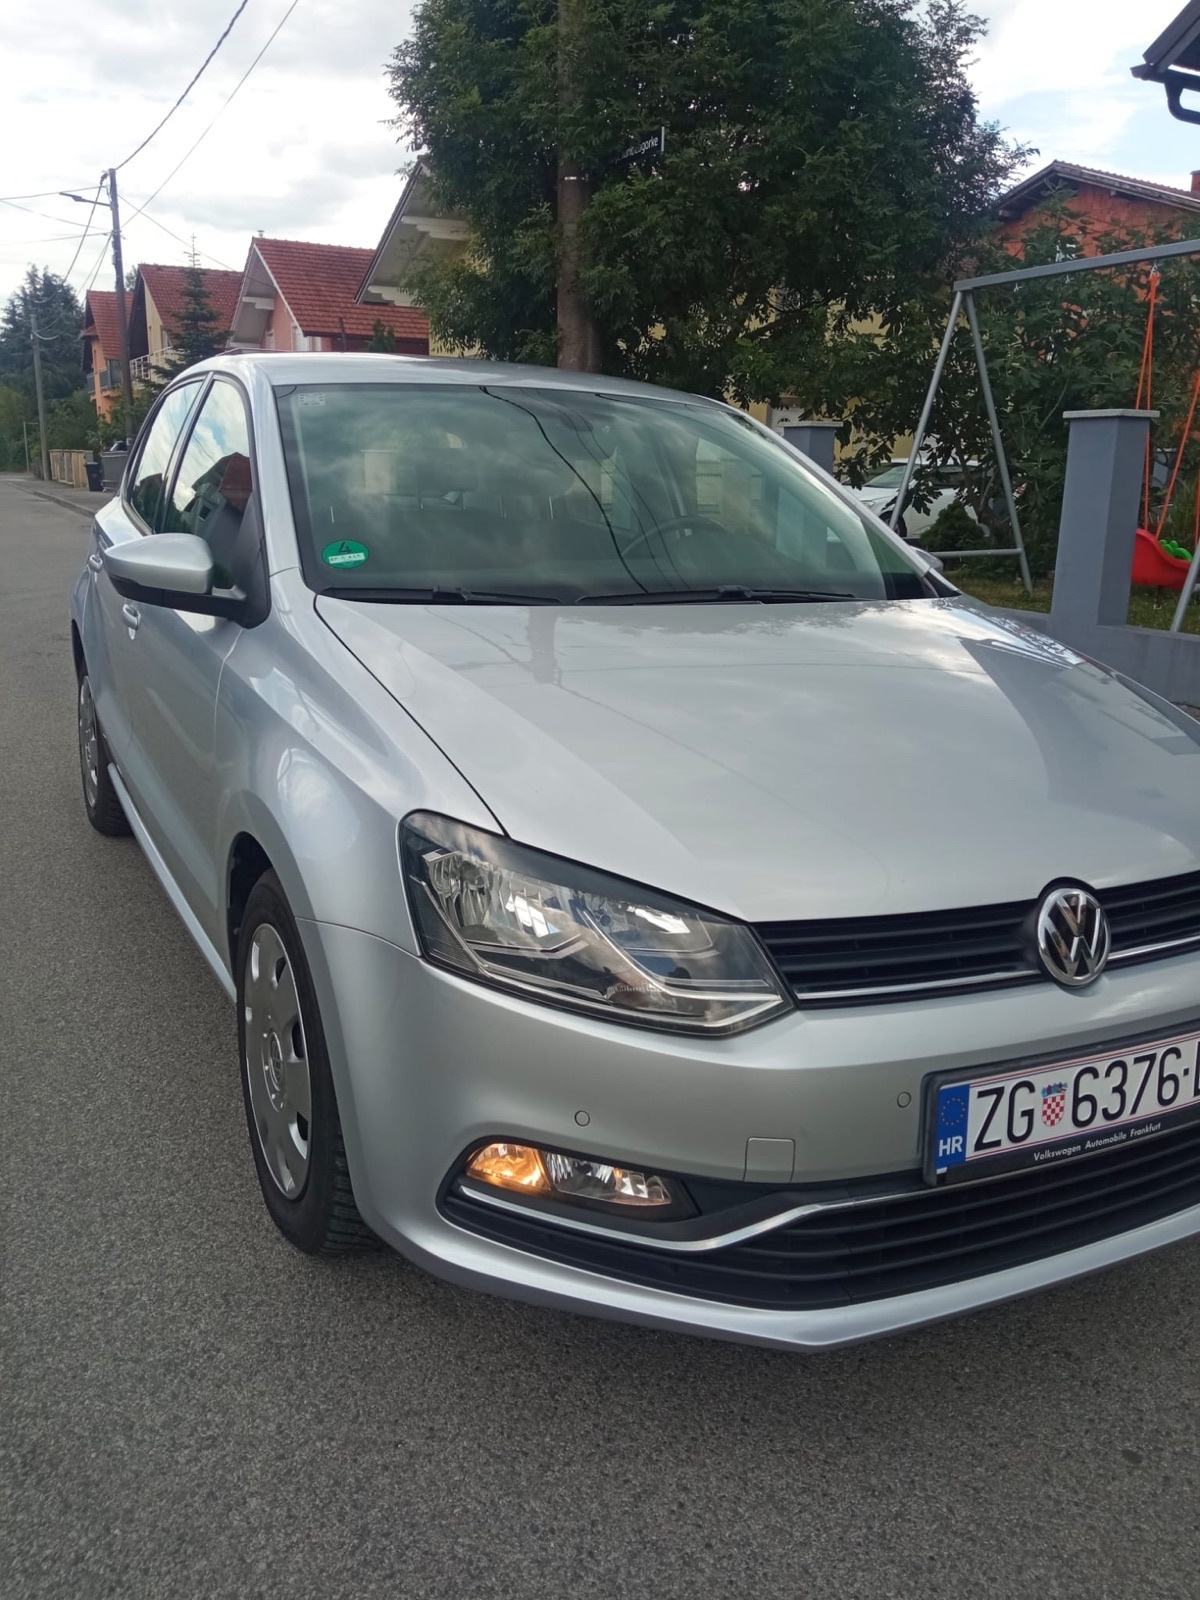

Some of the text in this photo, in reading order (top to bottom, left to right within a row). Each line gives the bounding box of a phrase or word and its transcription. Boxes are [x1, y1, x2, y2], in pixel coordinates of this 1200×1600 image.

[974, 1080, 1036, 1152] ZG
[938, 1135, 963, 1157] HR
[1033, 1122, 1161, 1161] Volkswagen Automobile Frankfurt
